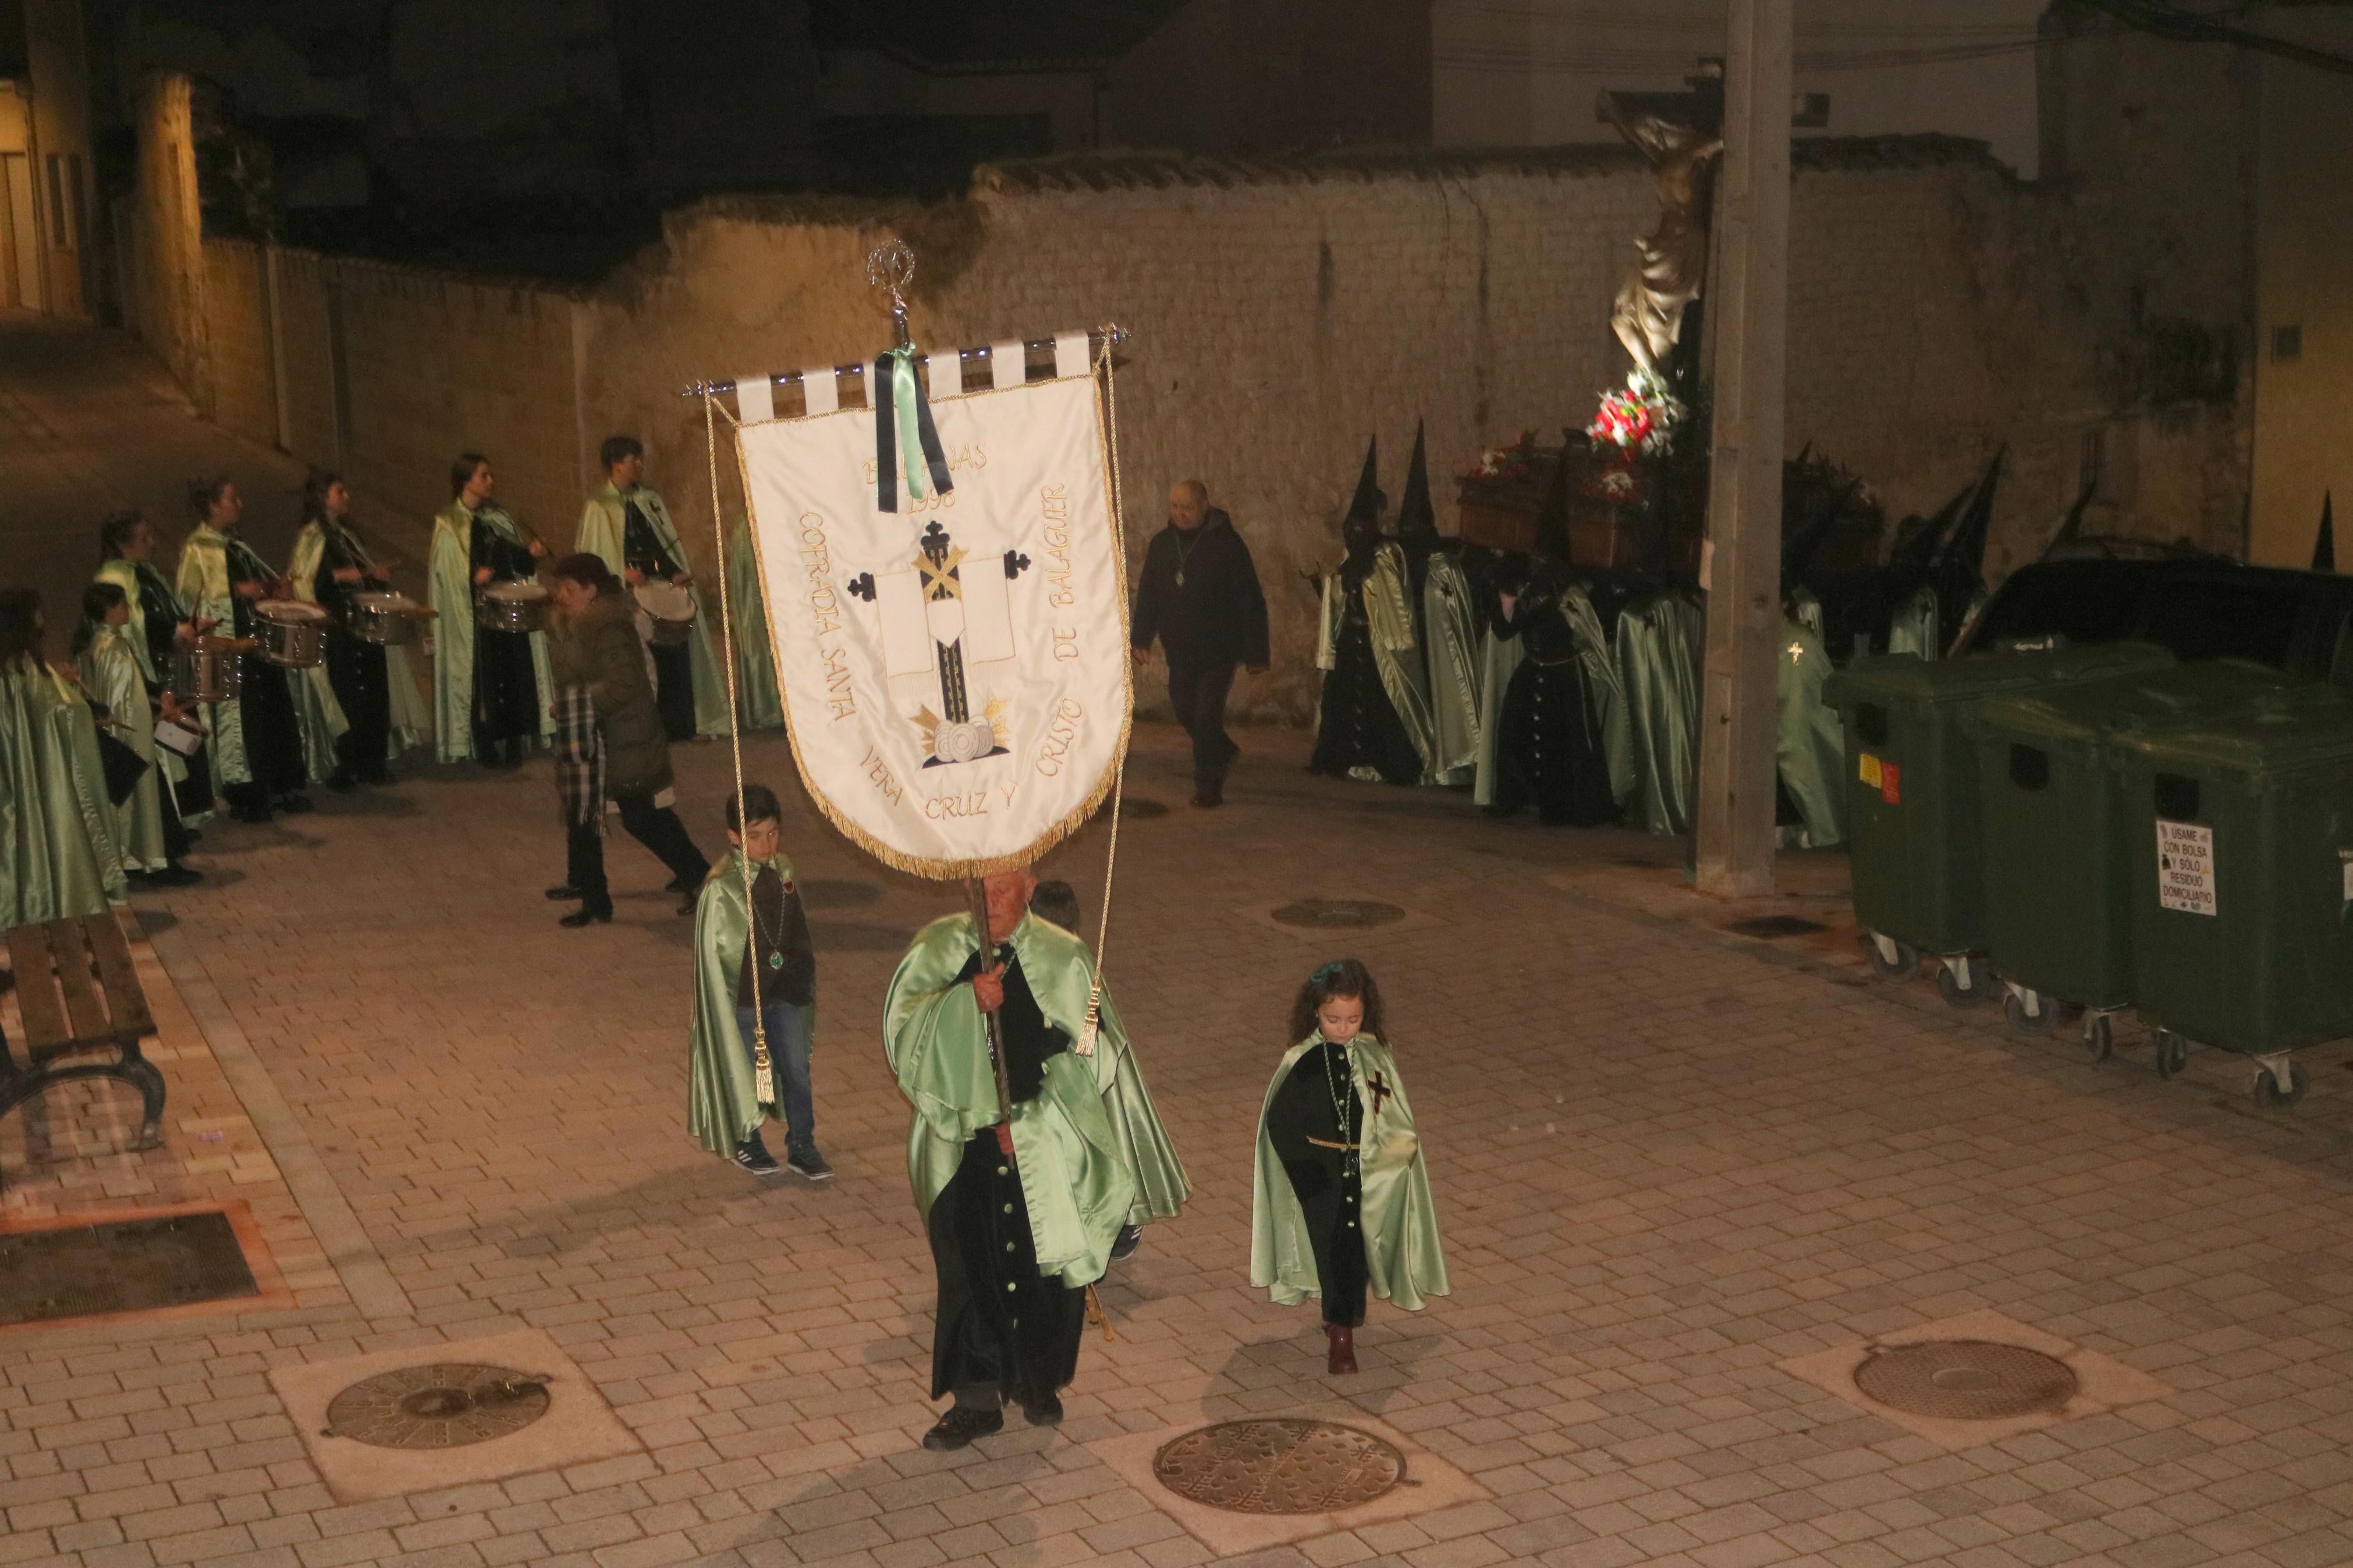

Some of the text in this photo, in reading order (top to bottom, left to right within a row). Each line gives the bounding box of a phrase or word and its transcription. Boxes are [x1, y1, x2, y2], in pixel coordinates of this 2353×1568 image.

[800, 483, 1083, 820] COFRADIA SANTA VERA CRUZ Y CRISTO DE BALAGUER
[2171, 825, 2198, 842] ÚSAME
[2164, 841, 2208, 858] CON BOLSA
[2172, 858, 2201, 872] Y SÓLO
[2170, 872, 2203, 887] RESIDUO
[2163, 885, 2212, 904] DOMICILIARIO
